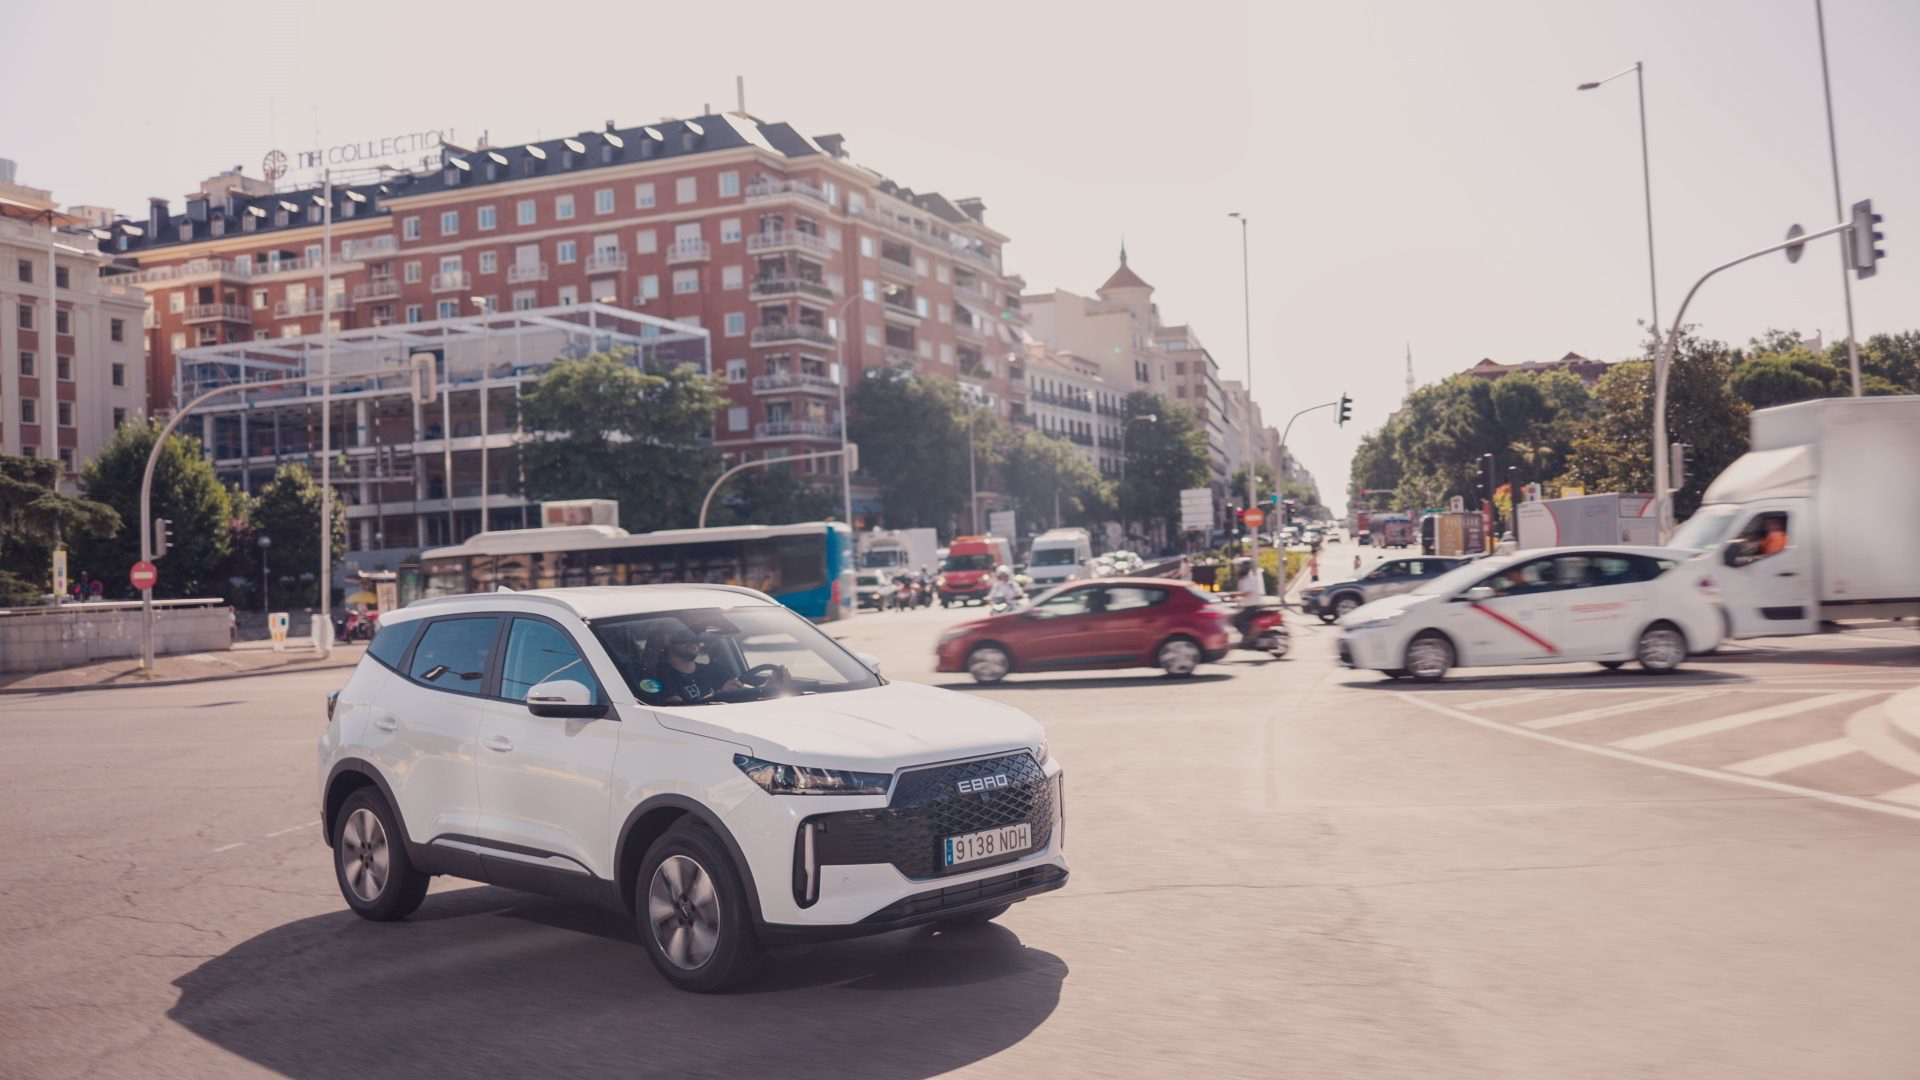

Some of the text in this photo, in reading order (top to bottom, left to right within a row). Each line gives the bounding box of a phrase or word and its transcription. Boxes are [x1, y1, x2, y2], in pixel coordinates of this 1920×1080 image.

[957, 774, 1009, 793] EBRO
[956, 828, 1027, 860] 9138 NDH
